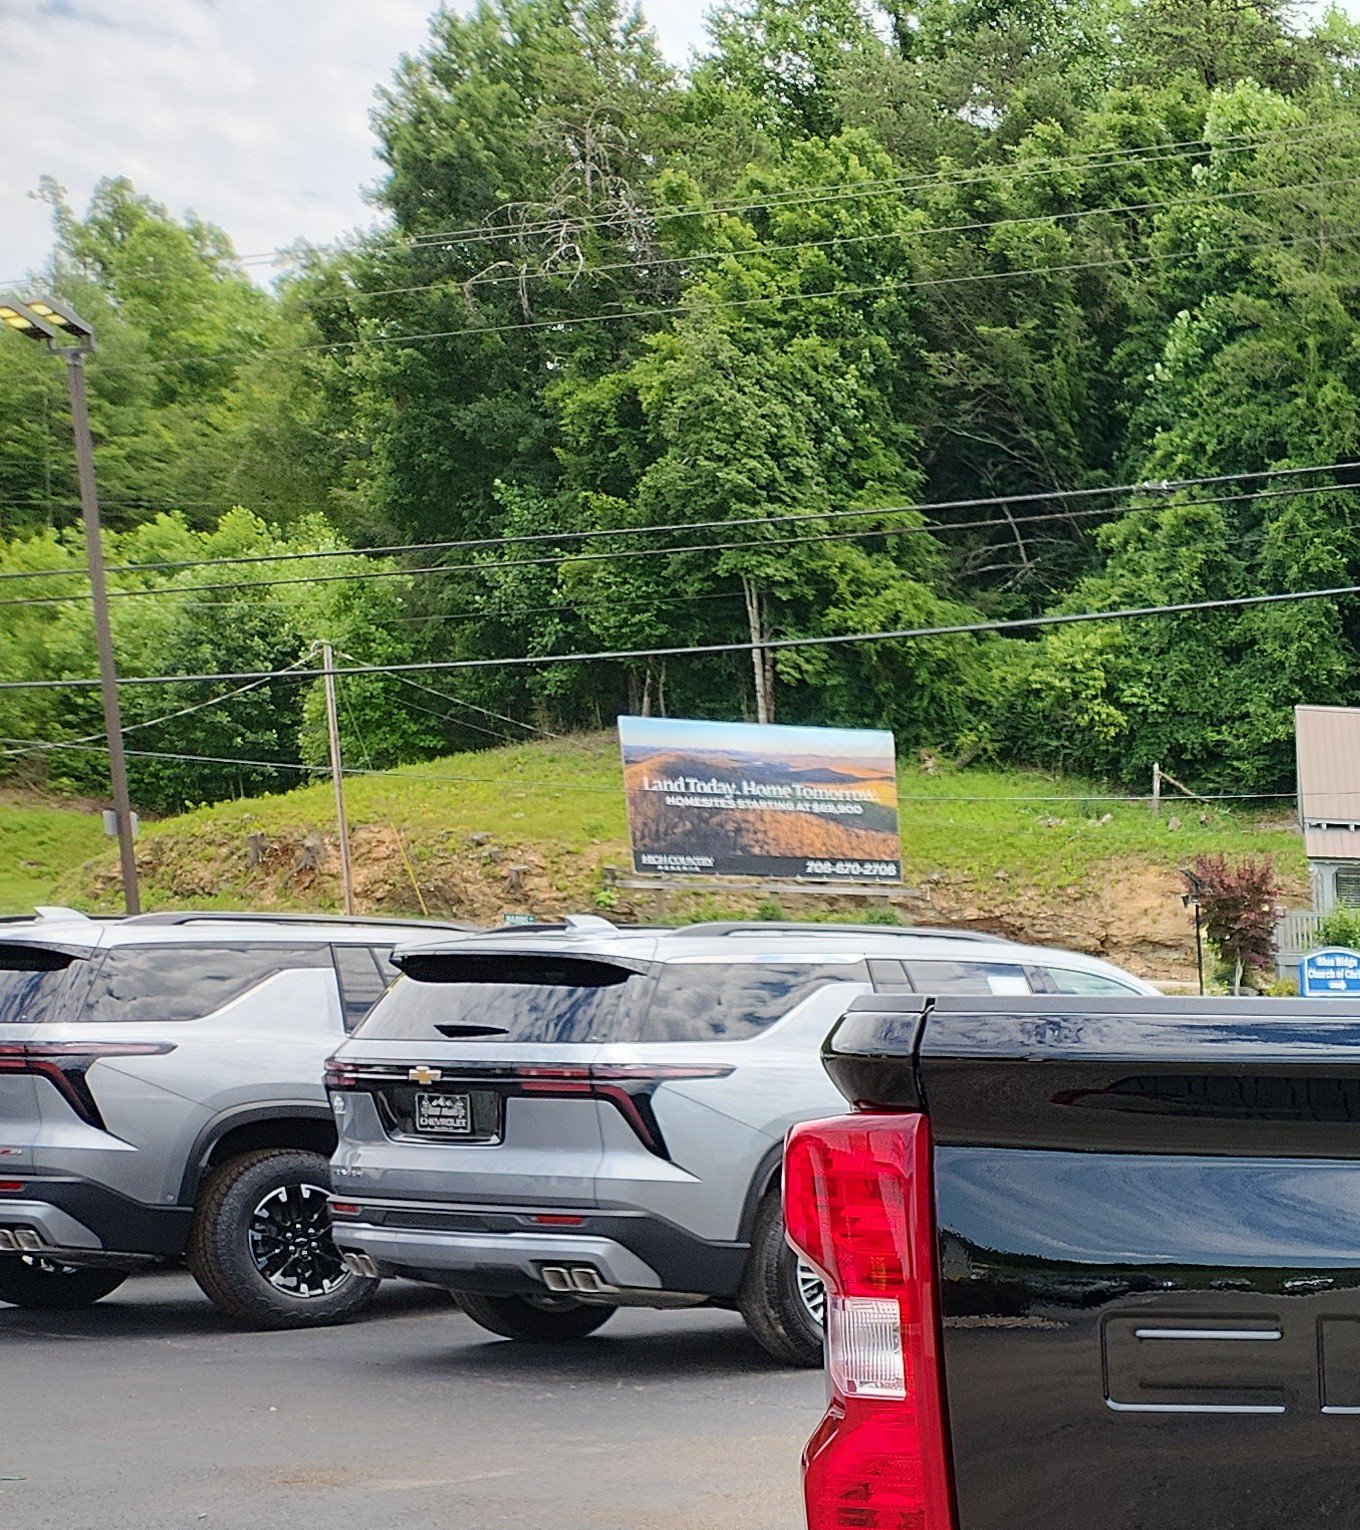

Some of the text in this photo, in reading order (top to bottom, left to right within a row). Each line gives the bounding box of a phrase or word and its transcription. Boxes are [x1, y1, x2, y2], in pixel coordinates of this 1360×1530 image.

[643, 776, 685, 793] Land
[742, 780, 792, 798] Home
[665, 795, 736, 809] HOMESITES
[737, 798, 795, 811] STARTING
[1308, 968, 1335, 979] Church
